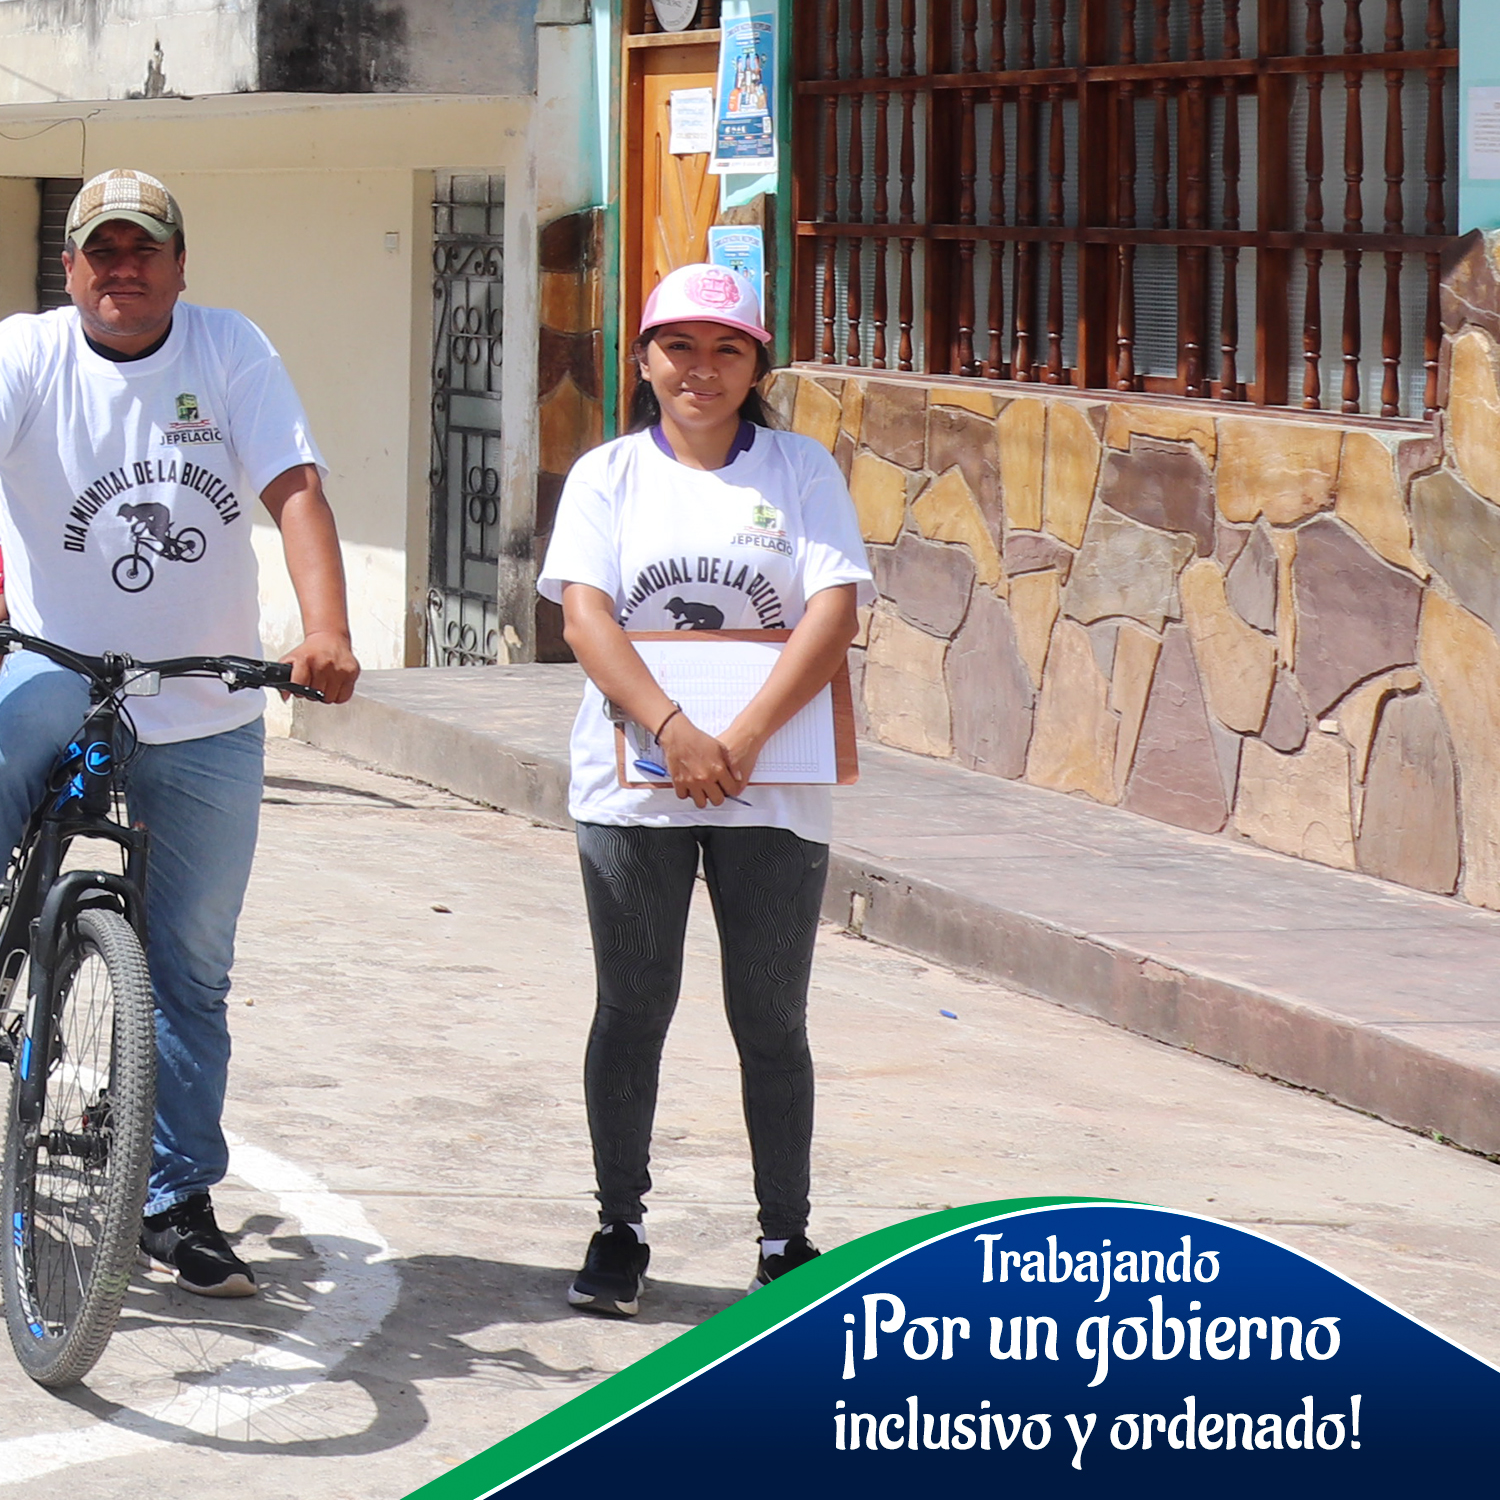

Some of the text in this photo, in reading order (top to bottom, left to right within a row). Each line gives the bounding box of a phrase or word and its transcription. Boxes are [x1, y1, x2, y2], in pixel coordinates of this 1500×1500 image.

[64, 459, 241, 553] DIA MUNDIAL DE LA BICICLETA
[730, 535, 793, 555] JEPELACIO
[697, 556, 721, 584] DE
[722, 560, 749, 591] LA
[745, 571, 786, 629] BICICLE
